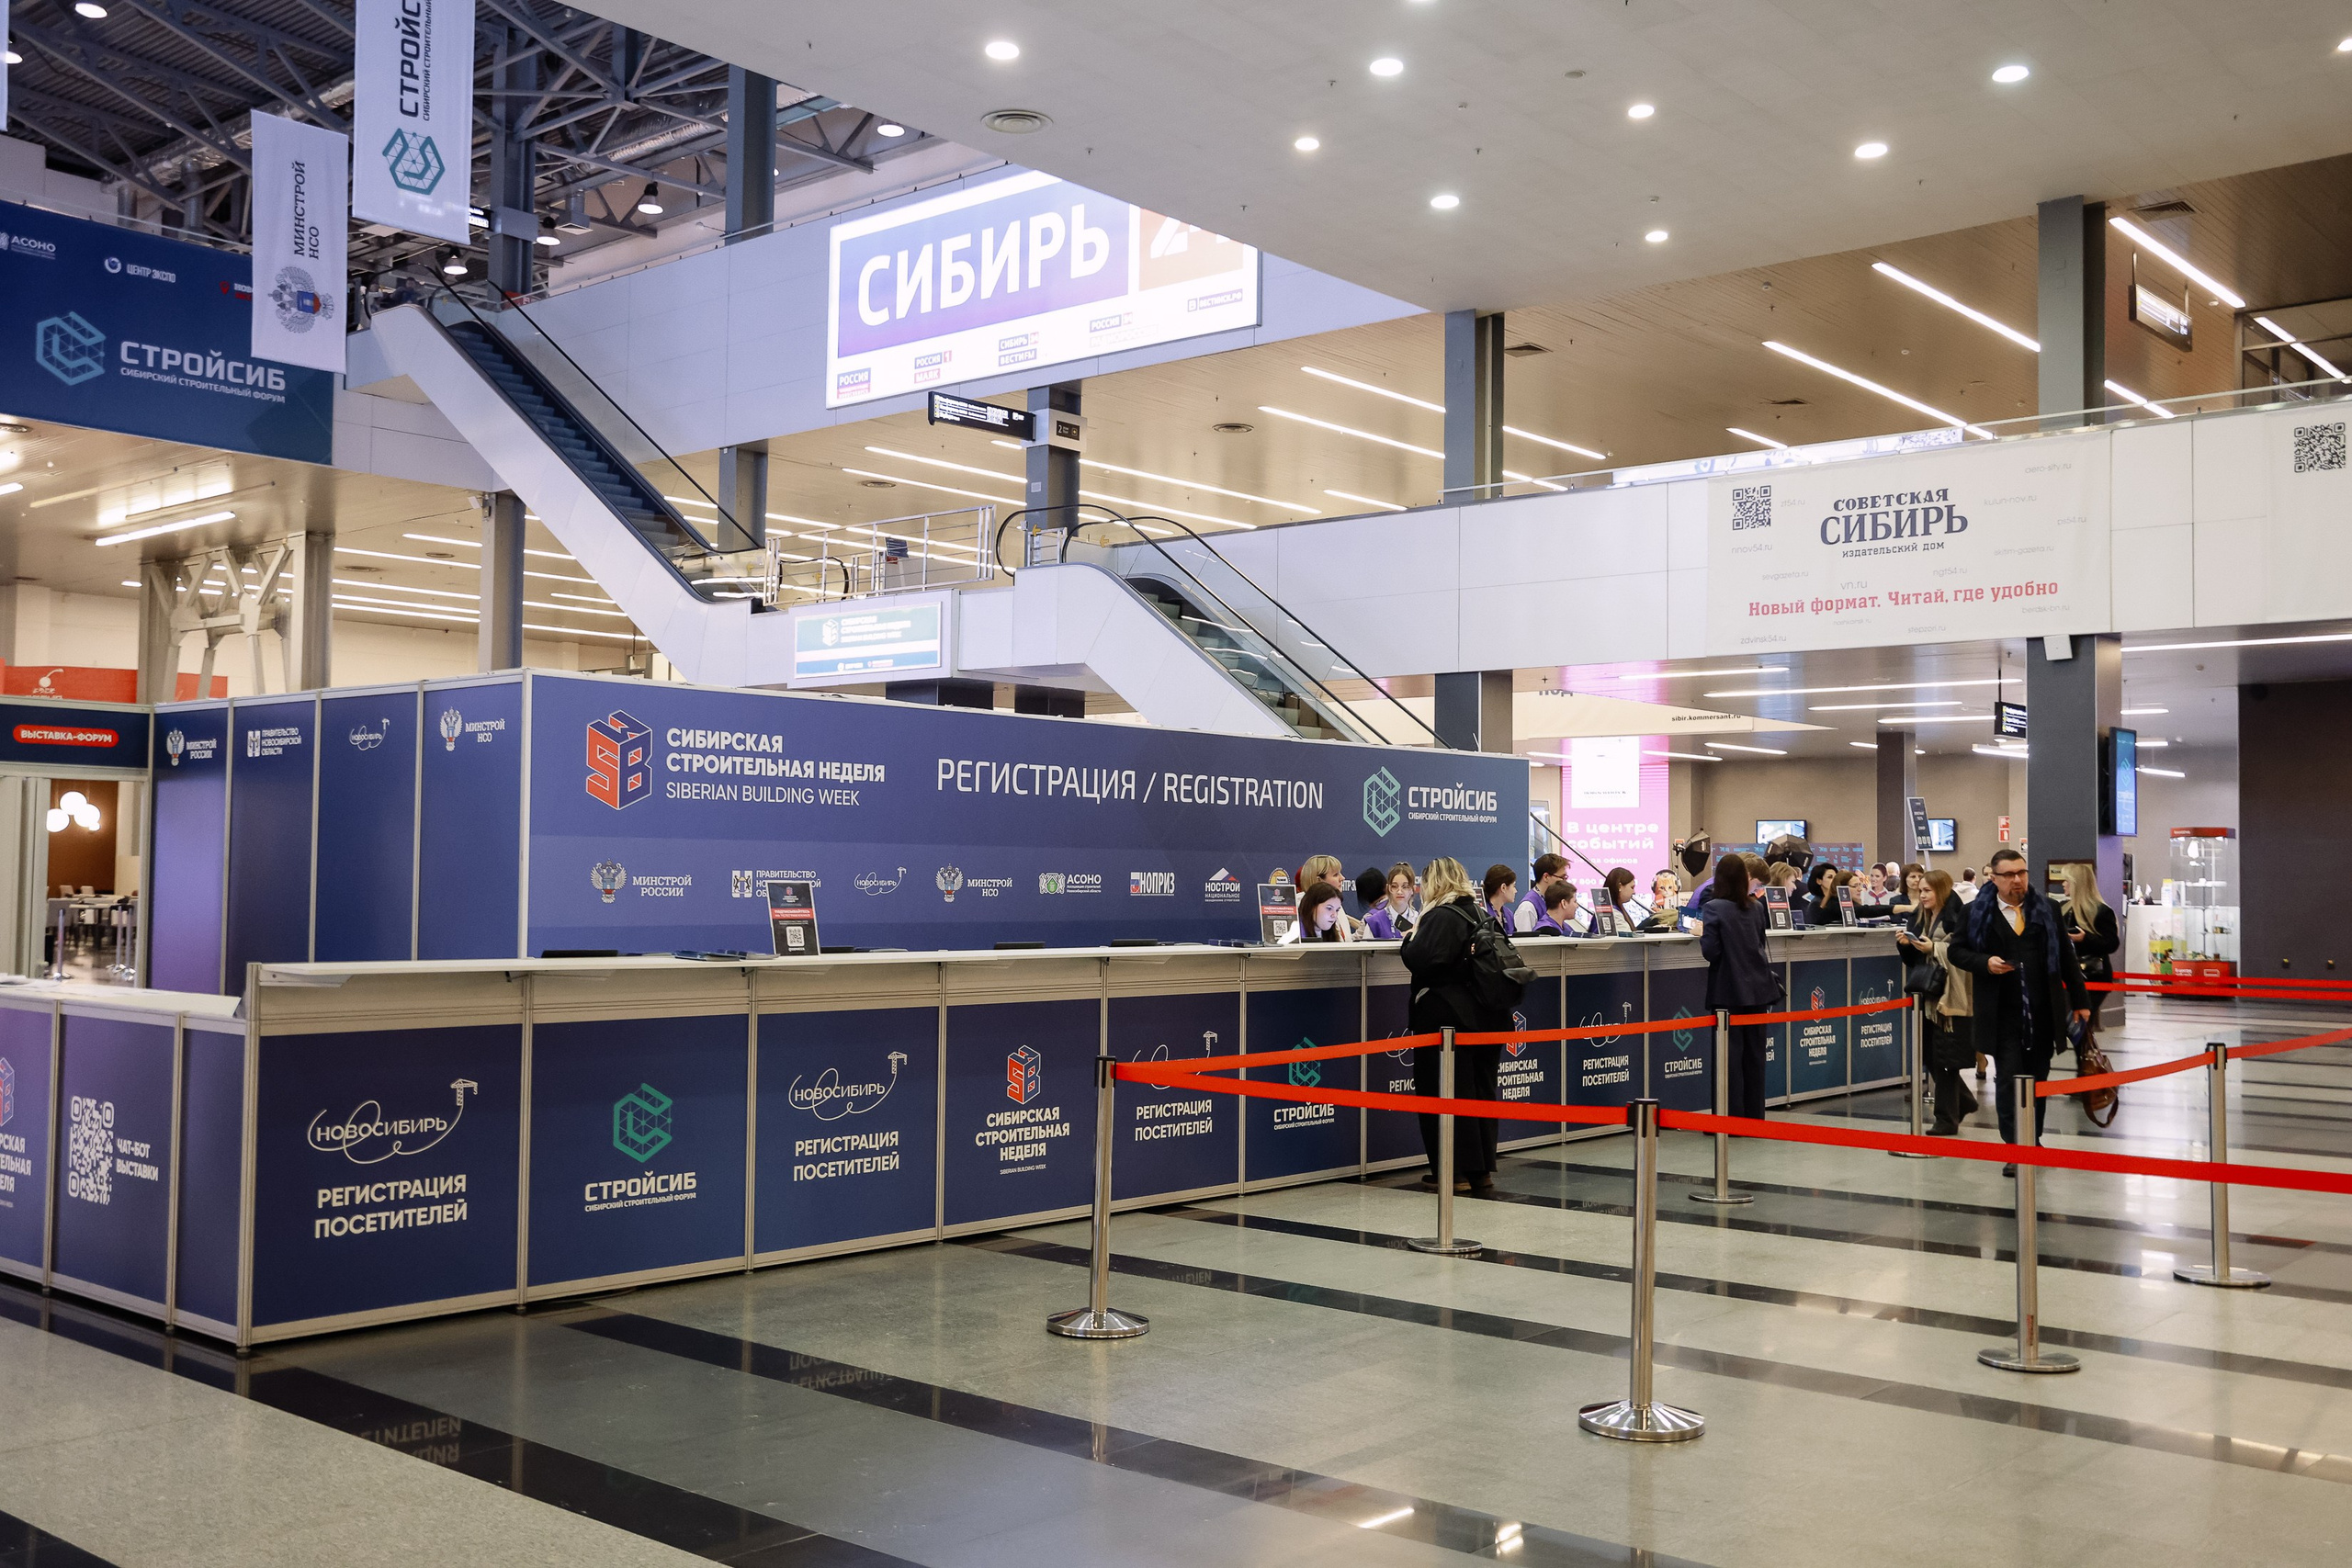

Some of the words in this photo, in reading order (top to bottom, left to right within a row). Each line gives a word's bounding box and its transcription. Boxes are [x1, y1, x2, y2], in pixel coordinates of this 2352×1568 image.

[395, 0, 421, 118] СТРОЙС
[423, 69, 432, 121] СИБИРСКИЙ
[292, 161, 305, 256] МИНСТРОЙ
[11, 235, 56, 253] АСОНО
[309, 227, 319, 260] НСО
[127, 264, 151, 277] ЦЕНТР
[152, 269, 176, 283] ЭКСПО
[857, 203, 1110, 327] СИБИРЬ
[1091, 316, 1120, 331] РОССИЯ
[1001, 335, 1028, 350] СИБИРЬ
[120, 341, 287, 390] СТРОЙСИБ
[916, 354, 942, 368] РОССИЯ
[120, 367, 176, 384] СИБИРСКИЙ
[178, 378, 251, 399] СТРОИТЕЛЬНЫЙ
[253, 389, 286, 404] ФОРУМ
[839, 371, 869, 387] РОССИЯ
[1833, 489, 1949, 512] СОВЕТСКАЯ
[1820, 504, 1968, 546] СИБИРЬ
[1842, 542, 1917, 558] издательский
[1923, 541, 1945, 552] дом
[1840, 581, 1868, 591] vn.ru
[1749, 600, 1804, 616] Новый
[1811, 595, 1881, 615] формат.
[1888, 589, 1949, 606] Читай,
[1953, 587, 1984, 603] где
[1991, 581, 2059, 603] удобно
[465, 718, 505, 733] МИНСТРОЙ
[1671, 714, 1741, 722] sibir.kommersant.ru
[20, 729, 112, 742] ВЫСТАВКА-ФОРУМ
[261, 728, 299, 737] ПРАВИТЕЛЬСТВО
[261, 735, 301, 746] НОВОСИБИРСКОЙ
[477, 732, 492, 743] НСО
[666, 728, 783, 753] СИБИРСКАЯ
[186, 738, 217, 750] МИНСТРОЙ
[261, 746, 283, 756] ОБЛАСТИ
[190, 750, 212, 760] РОССИИ
[666, 752, 814, 779] СТРОИТЕЛЬНАЯ
[820, 761, 885, 784] НЕДЕЛЯ
[937, 758, 1136, 805] РЕГИСТРАЦИЯ
[1164, 773, 1323, 809] REGISTRATION
[666, 782, 738, 801] SIBERIAN
[742, 785, 814, 804] BUILDING
[819, 789, 860, 807] WEEK
[1408, 782, 1498, 812] СТРОЙСИБ
[1408, 812, 1439, 821] СИБИРСКИЙ
[1440, 813, 1479, 823] СТРОИТЕЛЬНЫЙ
[1479, 816, 1498, 824] ФОРУМ
[1566, 821, 1579, 834] В
[1586, 823, 1659, 836] центре
[1568, 837, 1654, 850] событий
[633, 874, 692, 886] МИНСТРОЙ
[756, 870, 816, 878] ПРАВИТЕЛЬСТВО
[967, 877, 1012, 888] МИНСТРОЙ
[1067, 874, 1102, 885] АСОНО
[1140, 872, 1175, 894] НОПРИЗ
[641, 887, 684, 897] РОССИИ
[982, 888, 999, 897] НСО
[1804, 1025, 1832, 1036] СИБИРСКАЯ
[1860, 1022, 1892, 1034] РЕГИСТРАЦИЯ
[1800, 1035, 1836, 1047] СТРОИТЕЛЬНАЯ
[1860, 1033, 1893, 1048] ПОСЕТИТЕЛЕЙ
[1808, 1046, 1826, 1057] НЕДЕЛЯ
[1498, 1059, 1538, 1073] ИБИРСКАЯ
[1583, 1055, 1629, 1071] РЕГИСТРАЦИЯ
[1664, 1056, 1702, 1073] СТРОЙСИБ
[1498, 1071, 1544, 1088] РОИТЕЛЬНАЯ
[1582, 1069, 1629, 1087] ПОСЕТИТЕЛЕЙ
[795, 1083, 886, 1101] НОВОСИБИРЬ
[1502, 1086, 1531, 1100] НЕДЕЛЯ
[986, 1106, 1060, 1127] СИБИРСКАЯ
[1136, 1099, 1212, 1120] РЕГИСТРАЦИЯ
[1273, 1101, 1335, 1122] СТРОЙСИБ
[316, 1117, 447, 1142] НОВОСИБИРЬ
[975, 1122, 1070, 1146] СТРОИТЕЛЬНАЯ
[1135, 1116, 1213, 1141] ПОСЕТИТЕЛЕЙ
[117, 1138, 151, 1158] ЧАТ-БОТ
[795, 1131, 899, 1156] РЕГИСТРАЦИЯ
[1000, 1143, 1046, 1161] НЕДЕЛЯ
[116, 1158, 159, 1181] ВЫСТАВКИ
[793, 1151, 899, 1181] ПОСЕТИТЕЛЕЙ
[317, 1174, 467, 1209] РЕГИСТРАЦИЯ
[584, 1170, 697, 1201] СТРОЙСИБ
[585, 1200, 623, 1212] СИБИРСКИЙ
[624, 1194, 673, 1207] СТРОИТЕЛЬНЫЙ
[674, 1192, 696, 1201] ФОРУМ
[314, 1198, 468, 1239] ПОСЕТИТЕЛЕЙ
